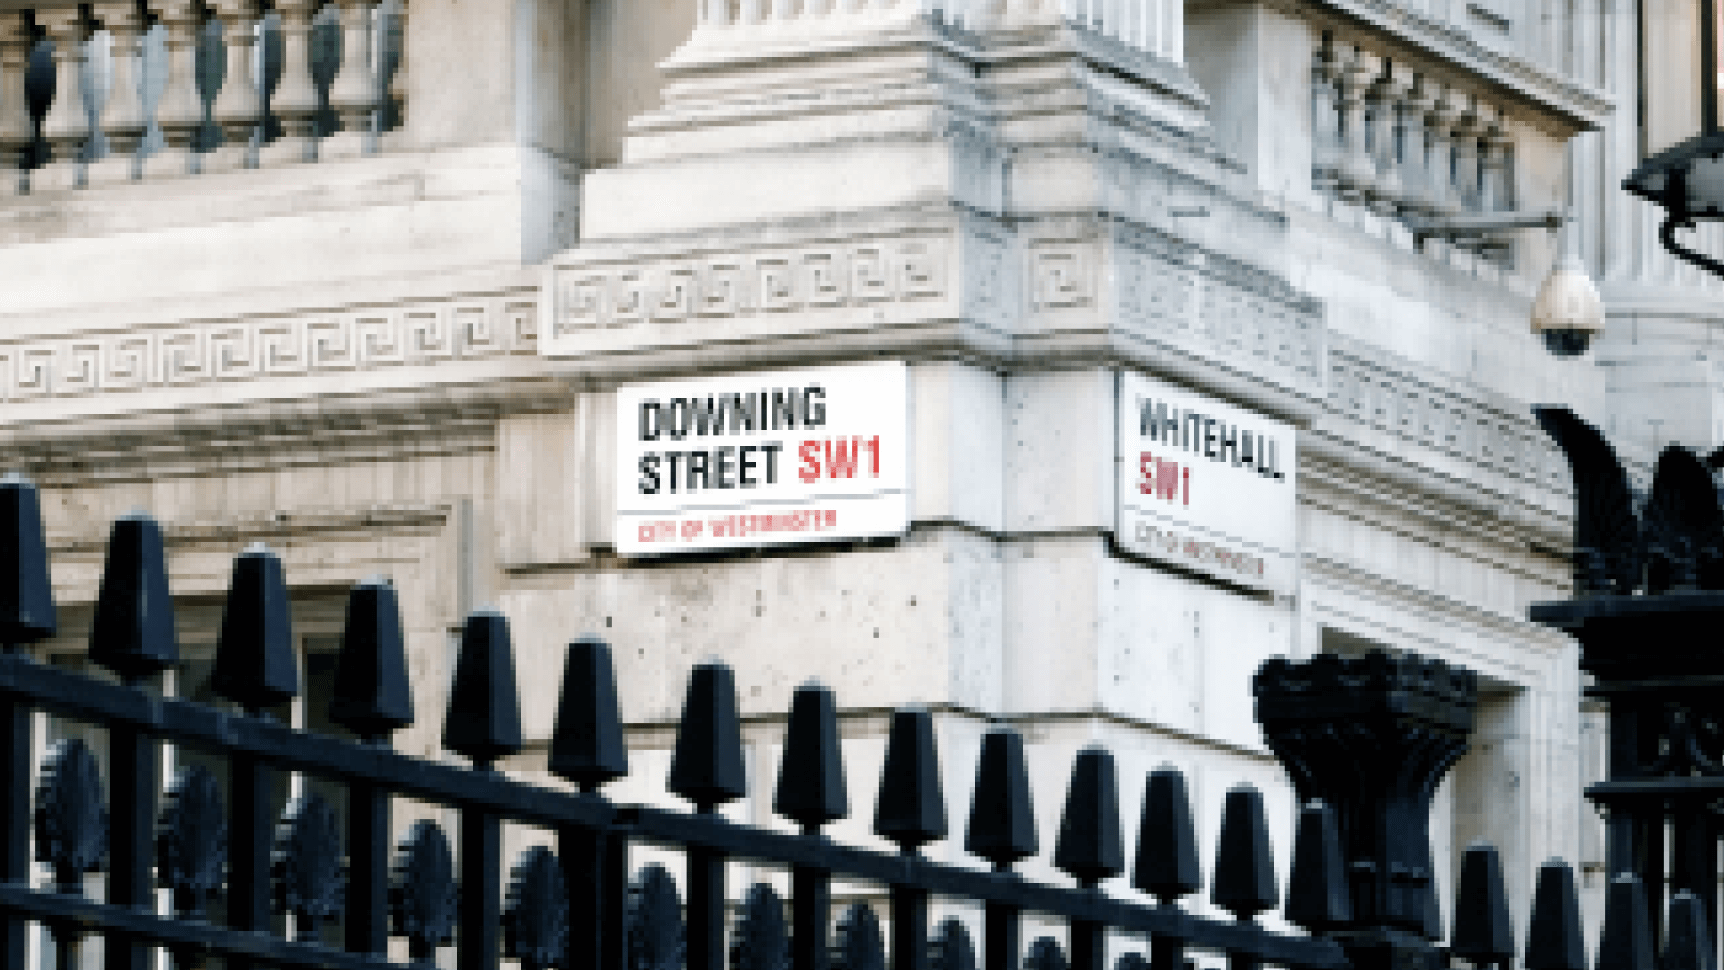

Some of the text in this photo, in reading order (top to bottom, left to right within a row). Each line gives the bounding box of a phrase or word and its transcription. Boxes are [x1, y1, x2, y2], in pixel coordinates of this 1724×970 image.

[638, 382, 826, 441] DOWNING
[1138, 397, 1285, 483] WHITEHALL
[638, 435, 880, 494] STREET SW1
